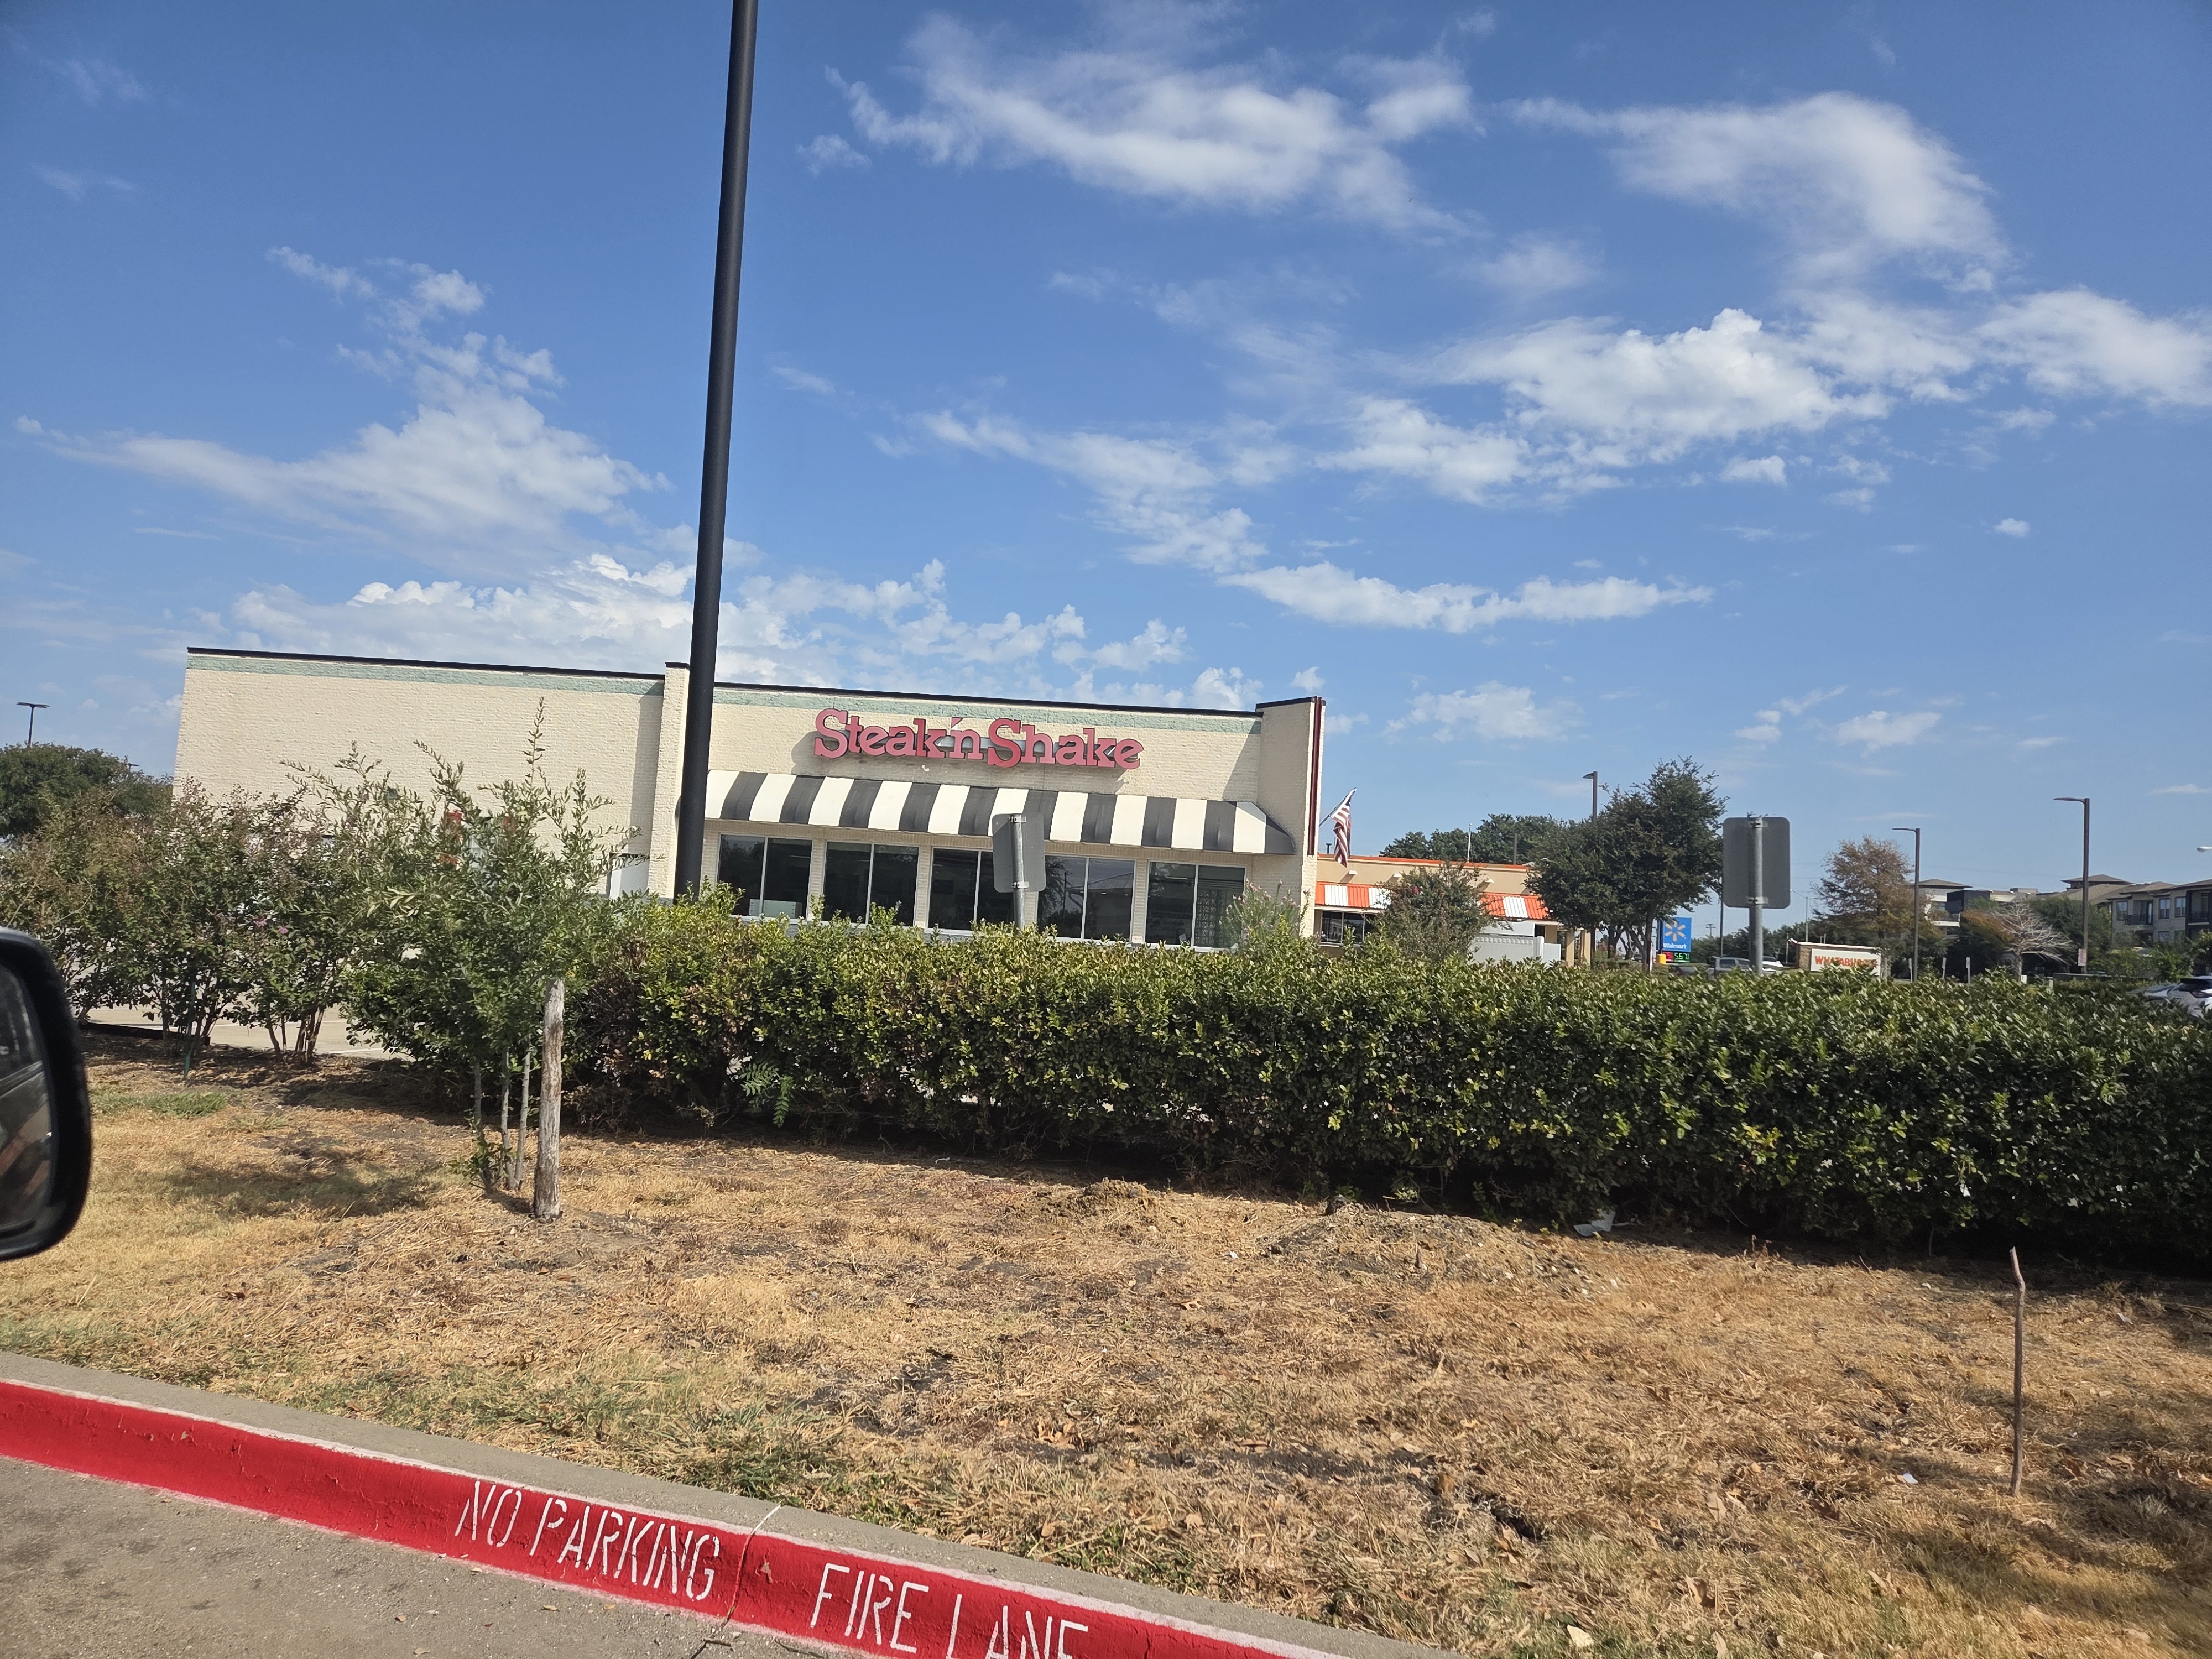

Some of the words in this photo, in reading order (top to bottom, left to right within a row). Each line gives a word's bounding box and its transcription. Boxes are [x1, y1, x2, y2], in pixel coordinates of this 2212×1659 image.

[987, 718, 1145, 769] Shake
[455, 1480, 523, 1548] NO
[529, 1497, 720, 1601] PARKING
[810, 1562, 930, 1654] FIRE
